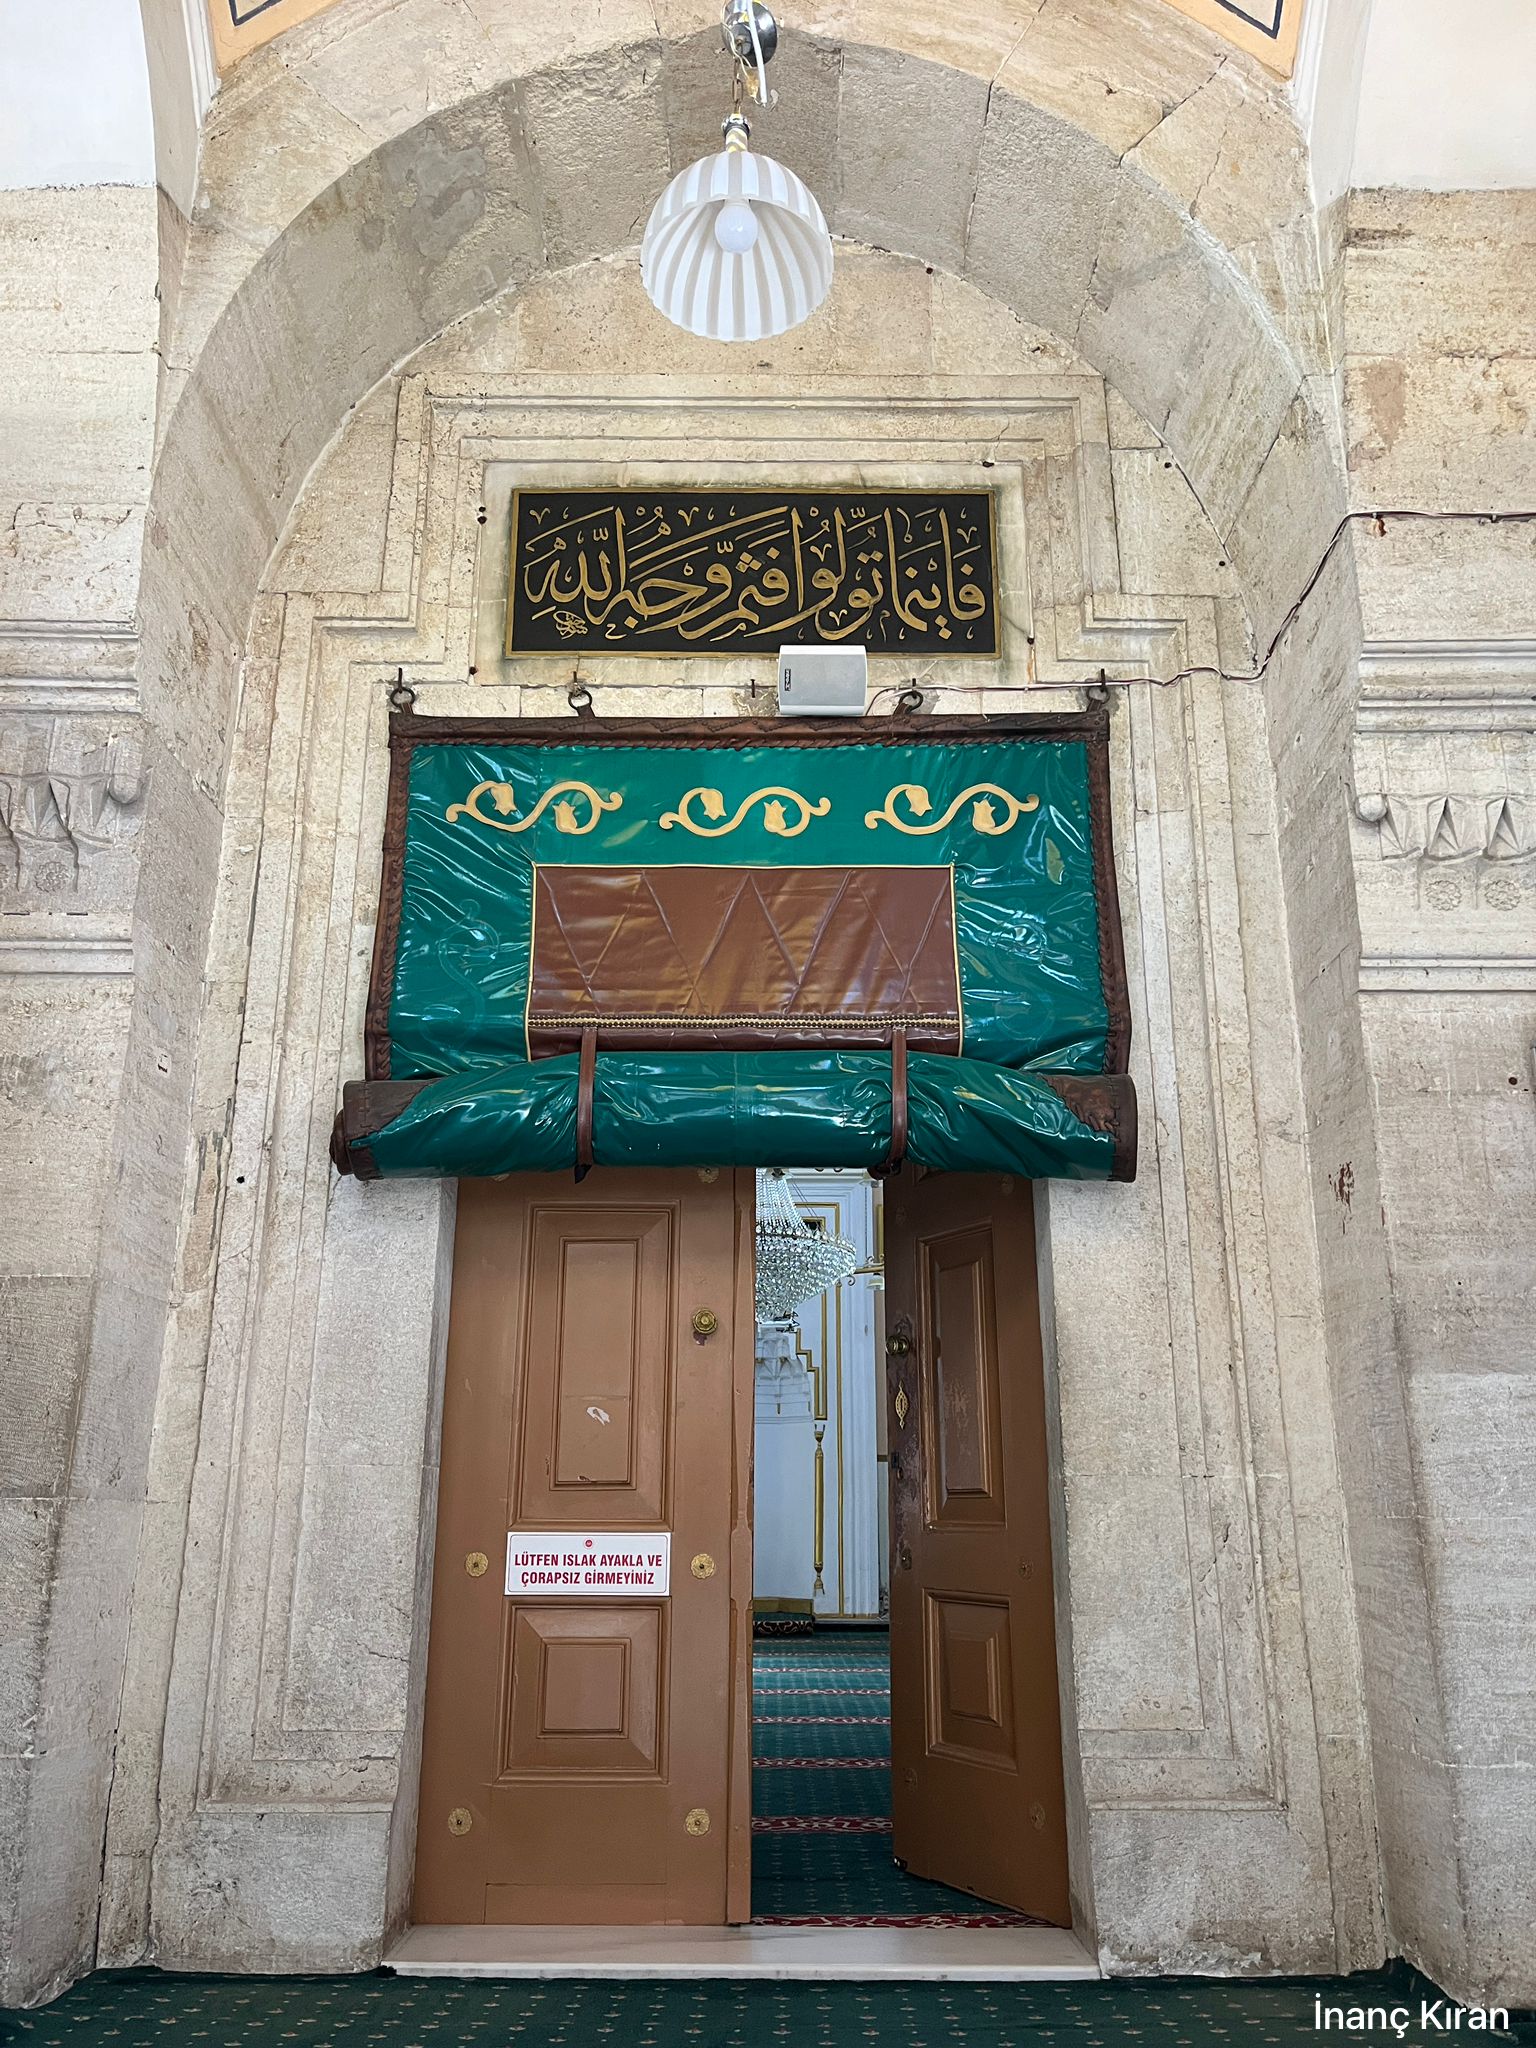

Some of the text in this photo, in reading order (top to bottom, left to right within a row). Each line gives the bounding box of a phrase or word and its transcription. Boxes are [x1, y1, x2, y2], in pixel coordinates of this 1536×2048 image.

[514, 1551, 663, 1567] LÜTFEN ISLAK AYAKLA VE
[521, 1569, 655, 1587] ÇORAPSIZ GİRMEYİNİZ
